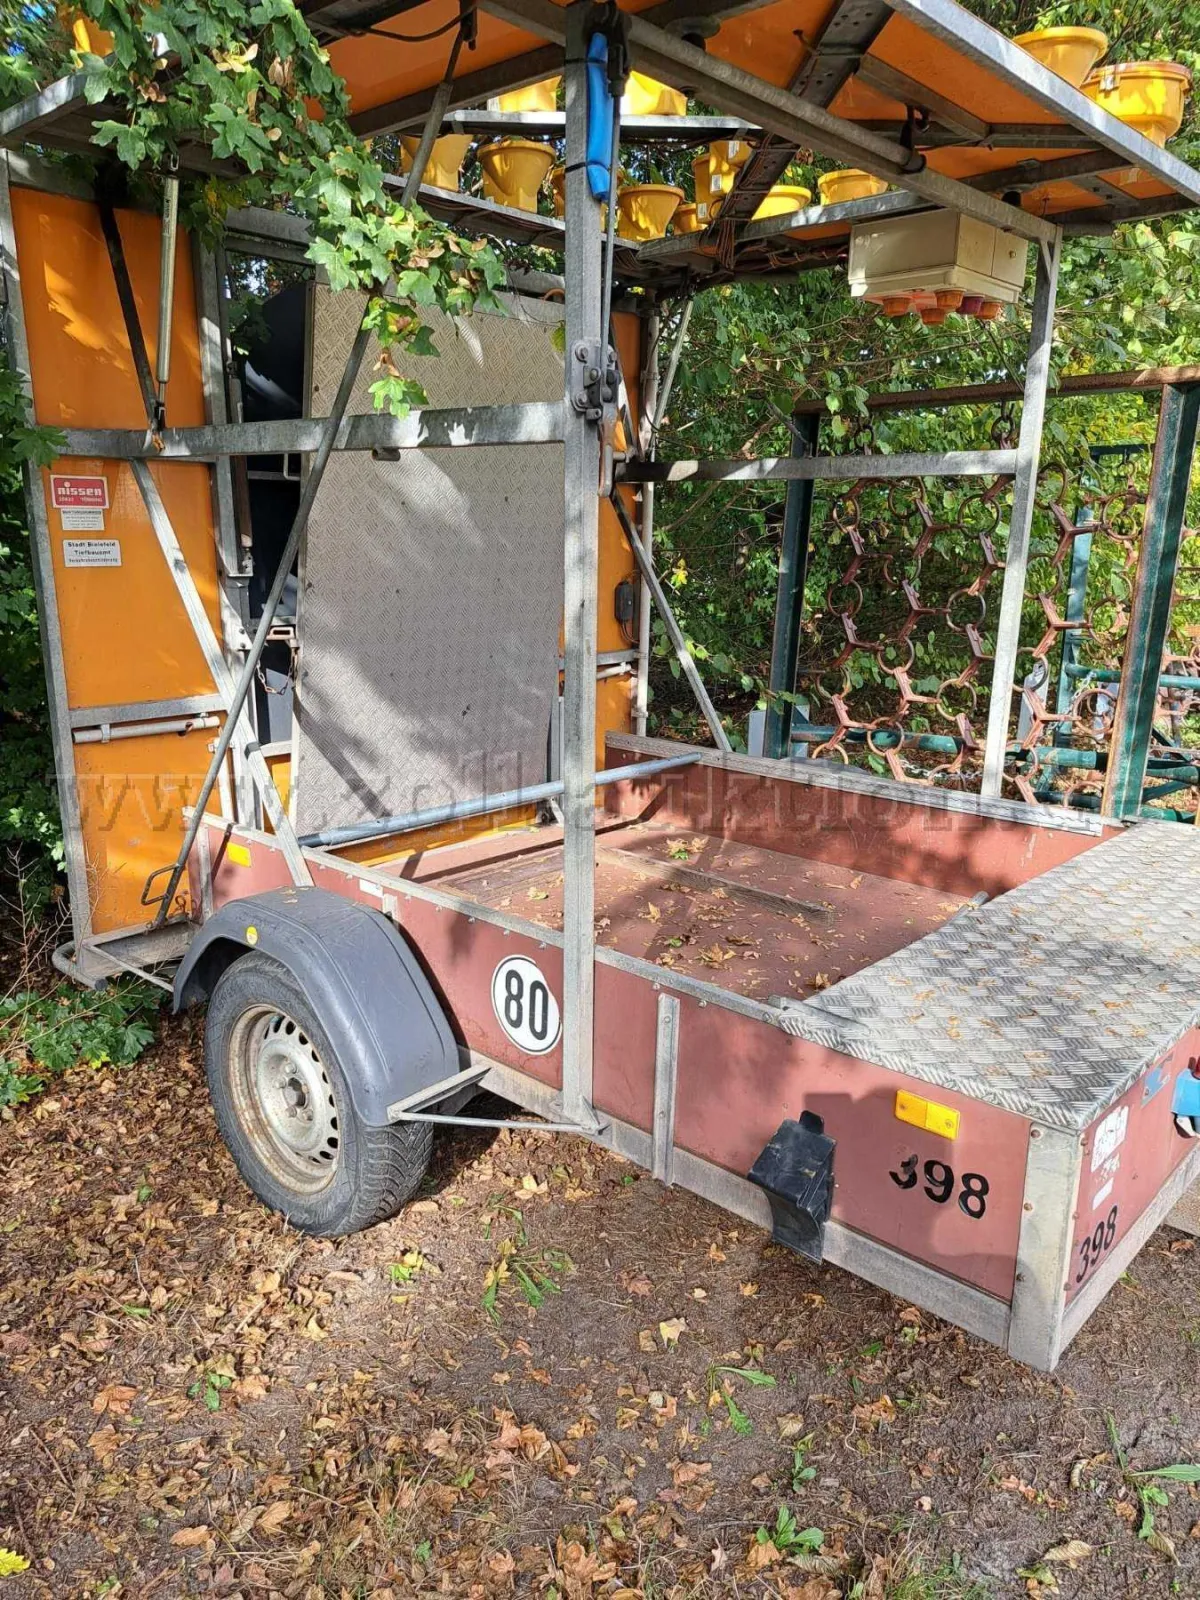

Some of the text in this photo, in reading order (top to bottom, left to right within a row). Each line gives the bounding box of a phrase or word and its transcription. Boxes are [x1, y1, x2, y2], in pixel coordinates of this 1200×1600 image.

[57, 481, 102, 496] nissen
[504, 969, 549, 1040] 80
[889, 1154, 990, 1219] 398
[1076, 1205, 1117, 1283] 398
